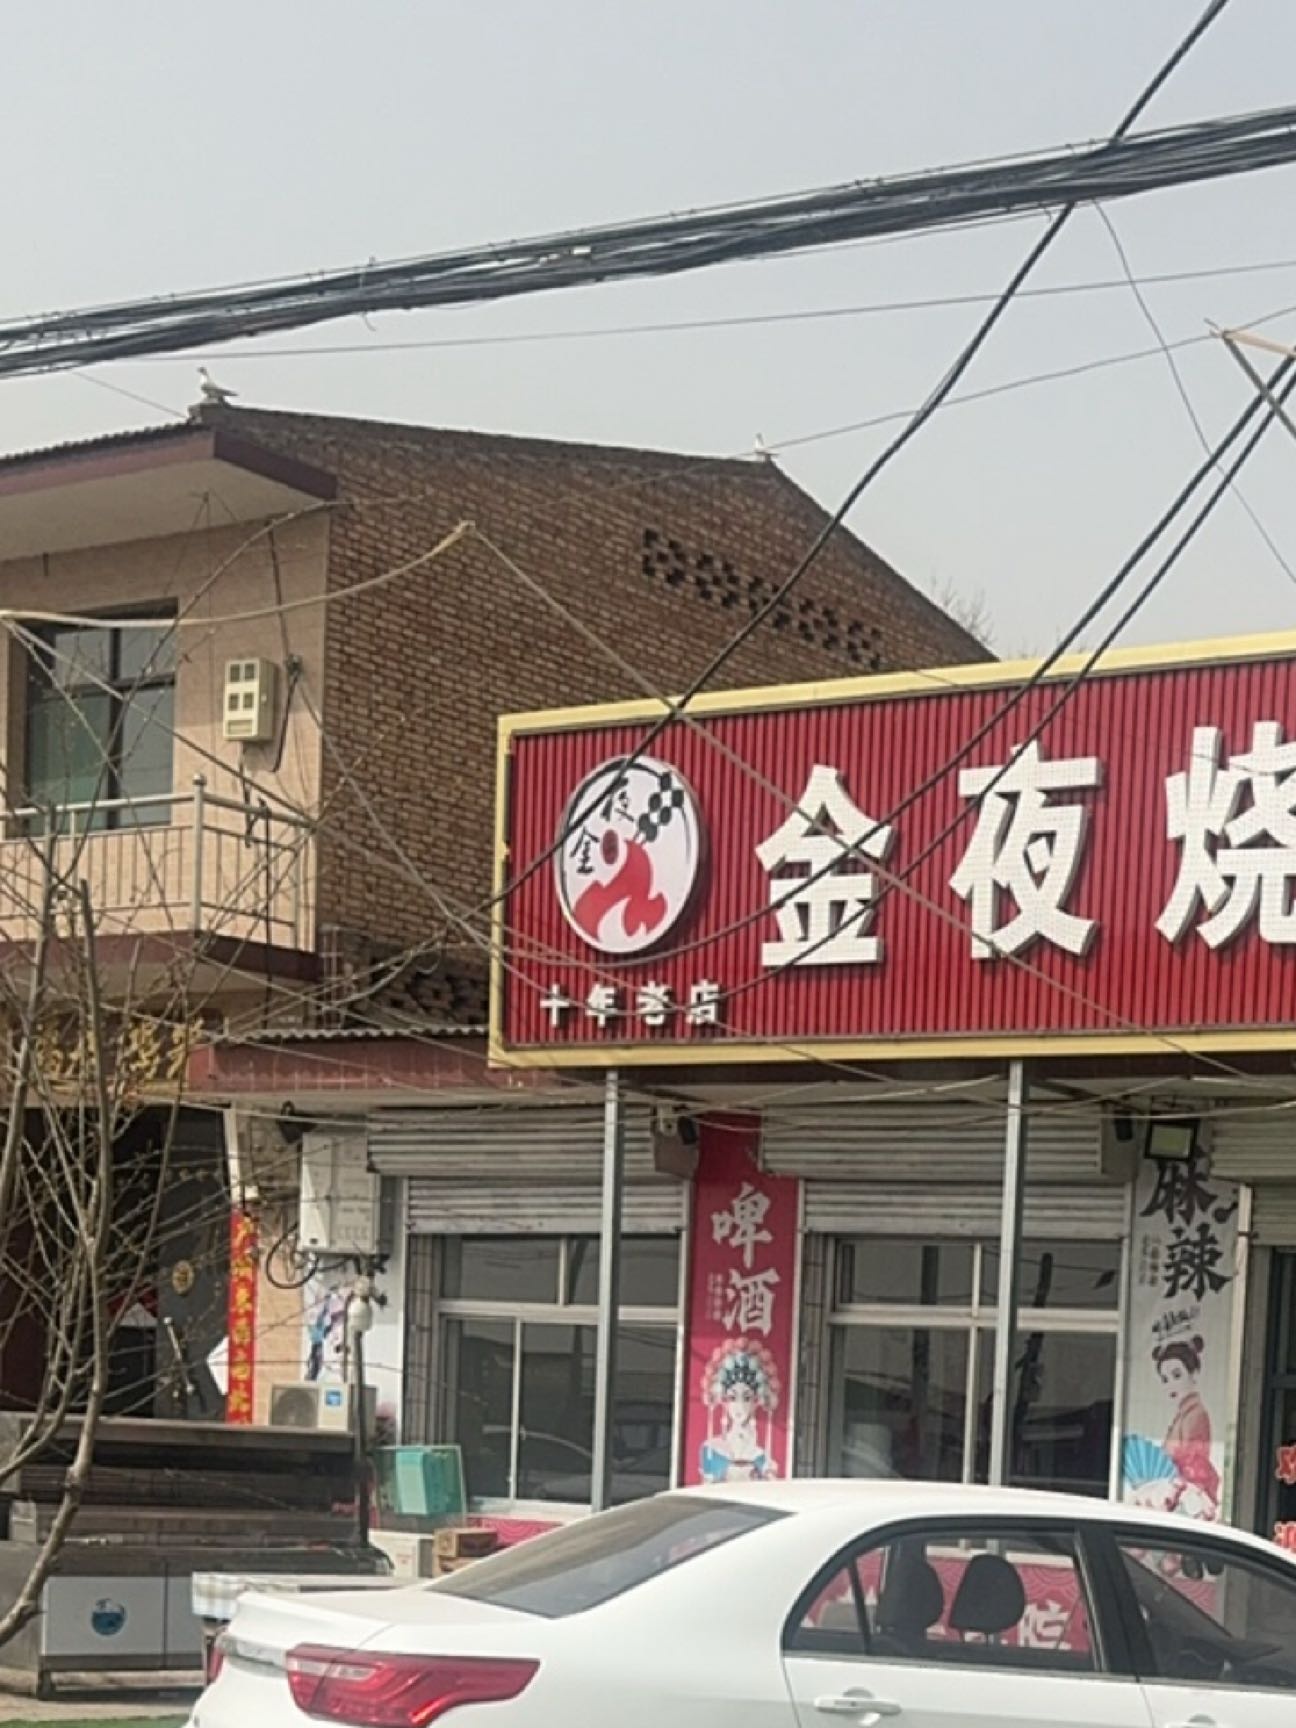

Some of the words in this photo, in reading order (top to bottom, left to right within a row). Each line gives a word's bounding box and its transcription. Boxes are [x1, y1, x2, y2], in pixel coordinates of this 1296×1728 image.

[539, 977, 722, 1030] 十年老店
[710, 1181, 781, 1336] 啤酒
[1139, 1145, 1233, 1303] 麻辣
